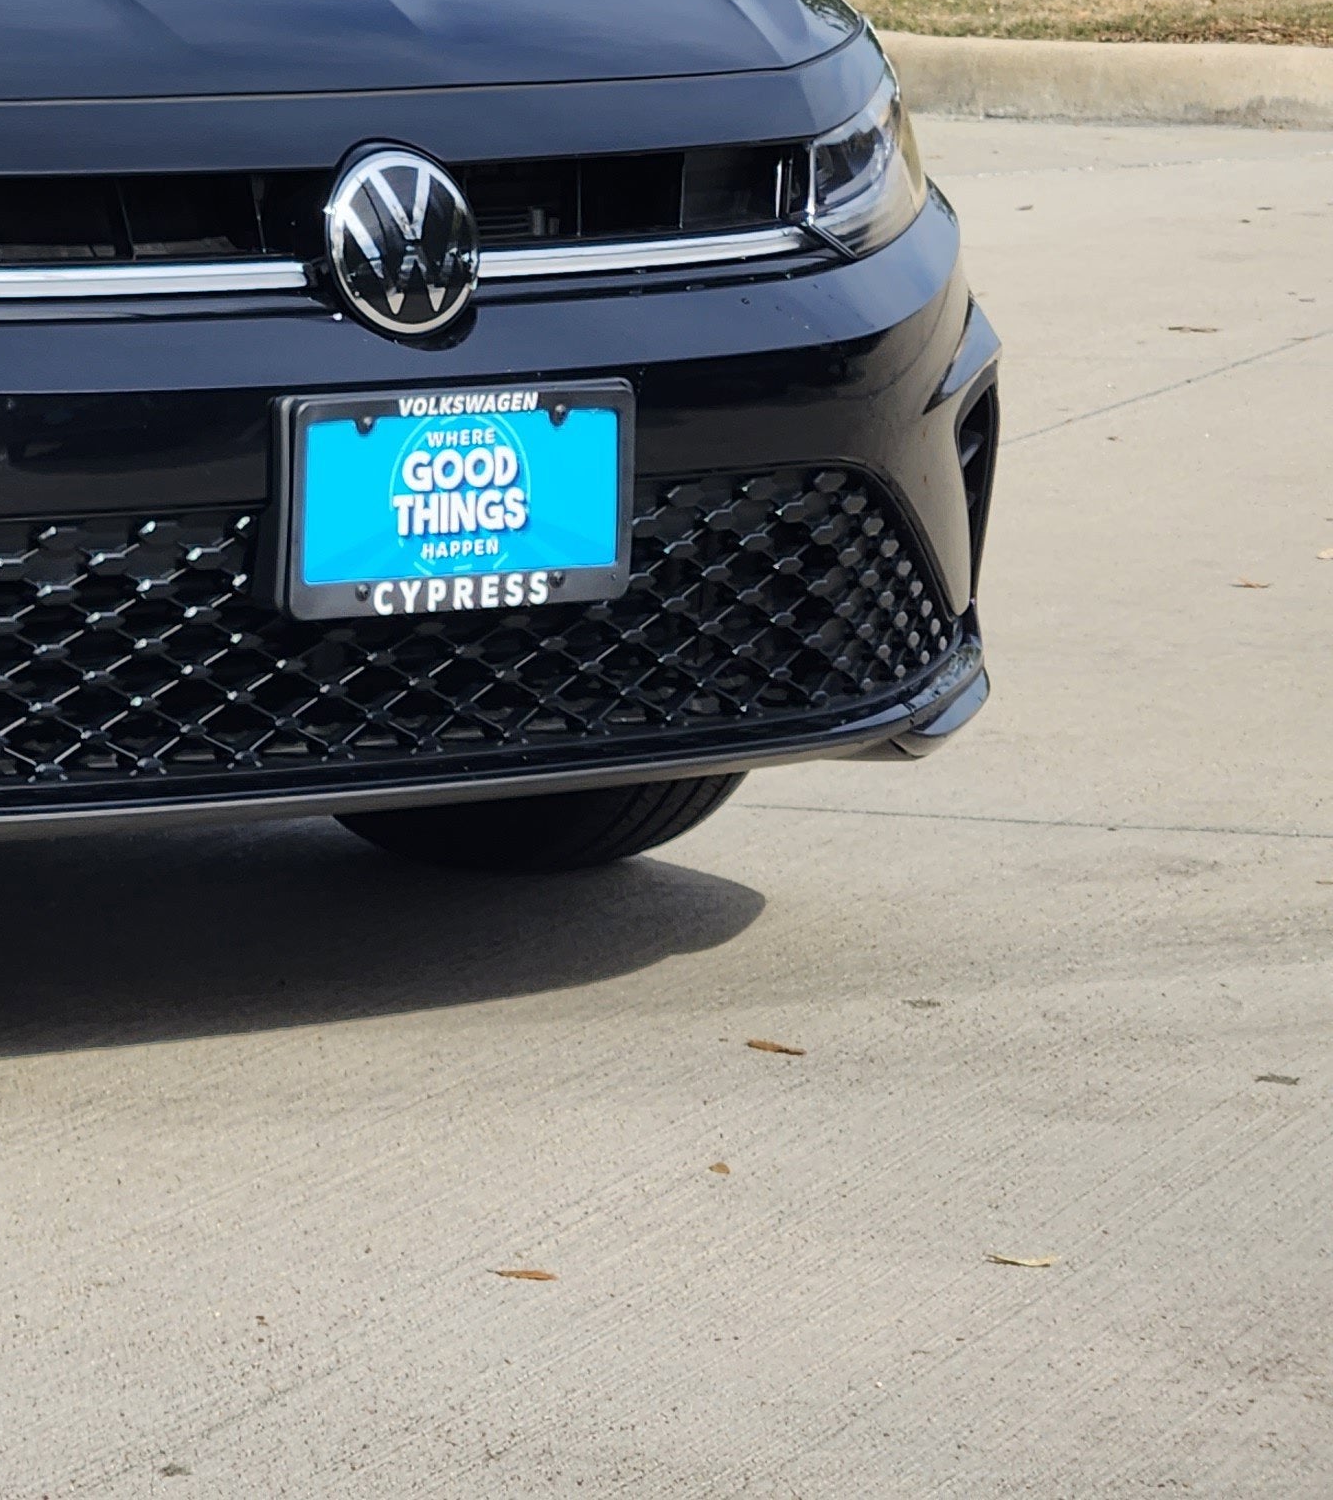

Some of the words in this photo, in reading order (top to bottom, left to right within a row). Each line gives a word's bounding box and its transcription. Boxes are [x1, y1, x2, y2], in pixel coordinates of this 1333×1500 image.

[398, 391, 539, 418] VOLKSWAGEN
[426, 426, 497, 448] WHERE
[401, 444, 519, 493] GOOD
[391, 486, 528, 537] THINGS
[421, 535, 499, 560] HAPPEN
[373, 570, 550, 616] CYPRESS
